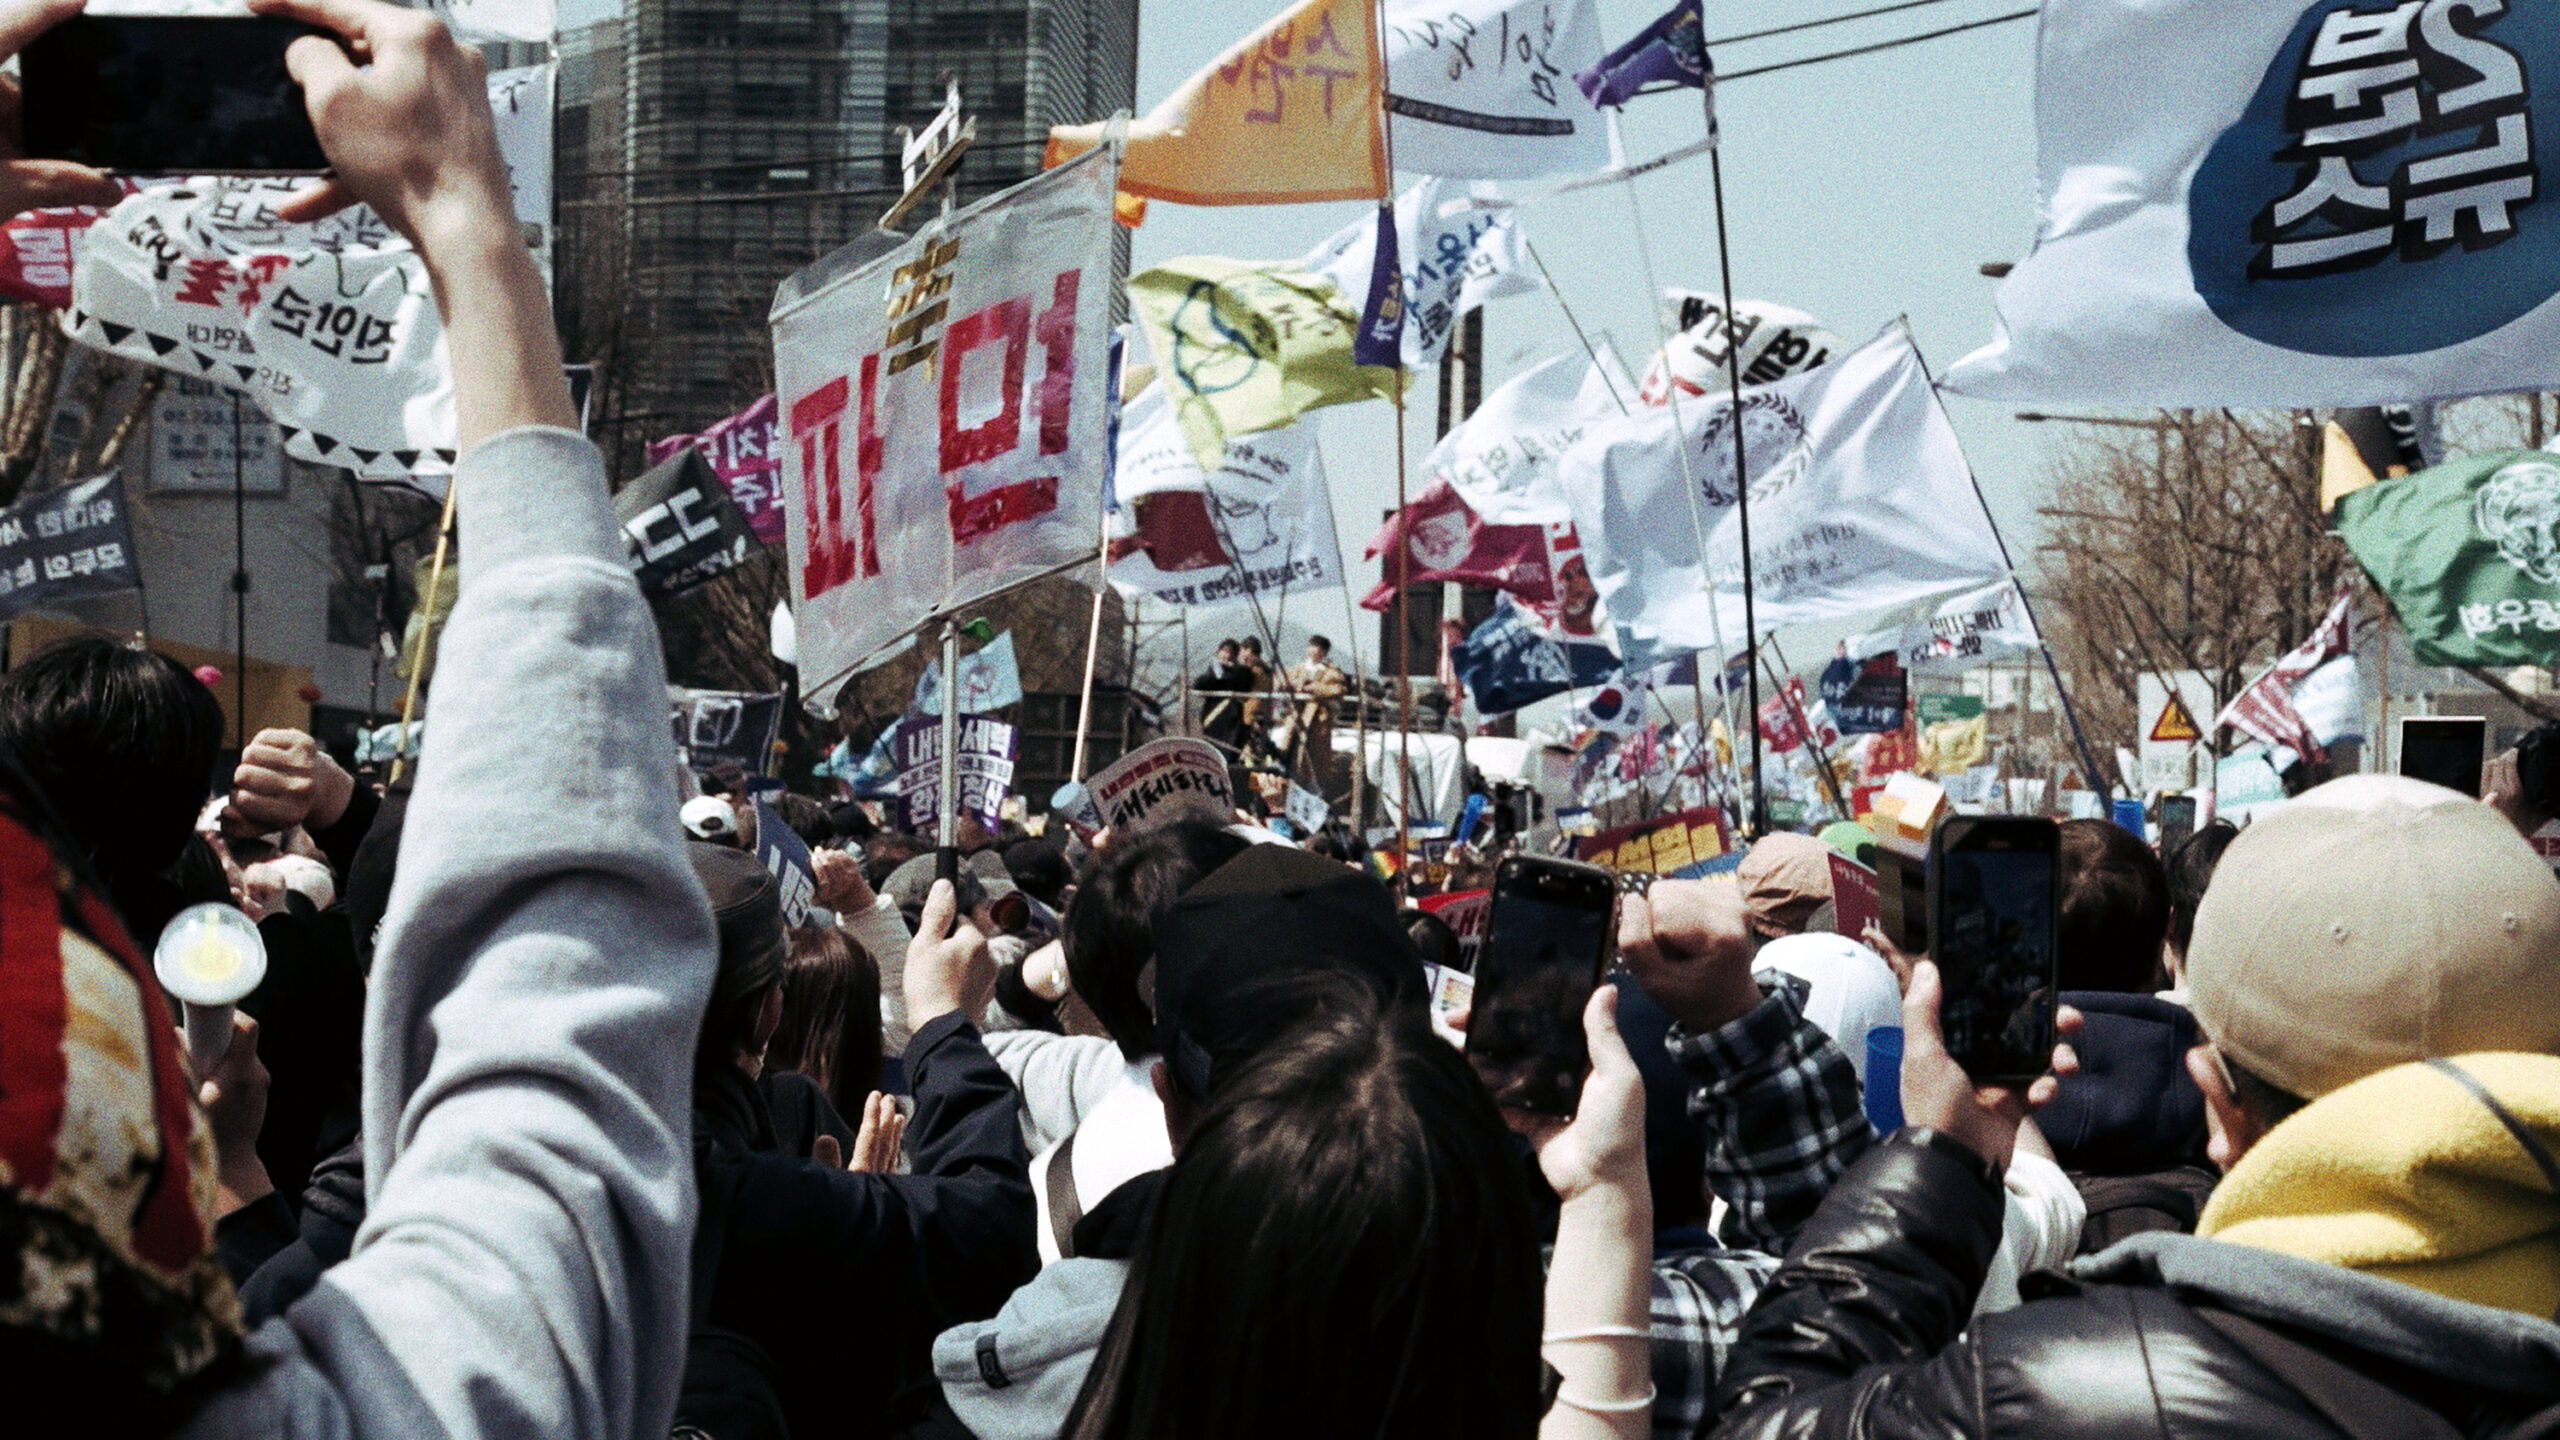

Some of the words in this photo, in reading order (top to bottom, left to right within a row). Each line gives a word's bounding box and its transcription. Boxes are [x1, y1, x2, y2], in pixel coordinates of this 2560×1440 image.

[792, 268, 1082, 600] 파면
[908, 719, 1013, 767] 내세력
[910, 774, 1005, 826] 완청산
[1108, 766, 1229, 828] 해체하라
